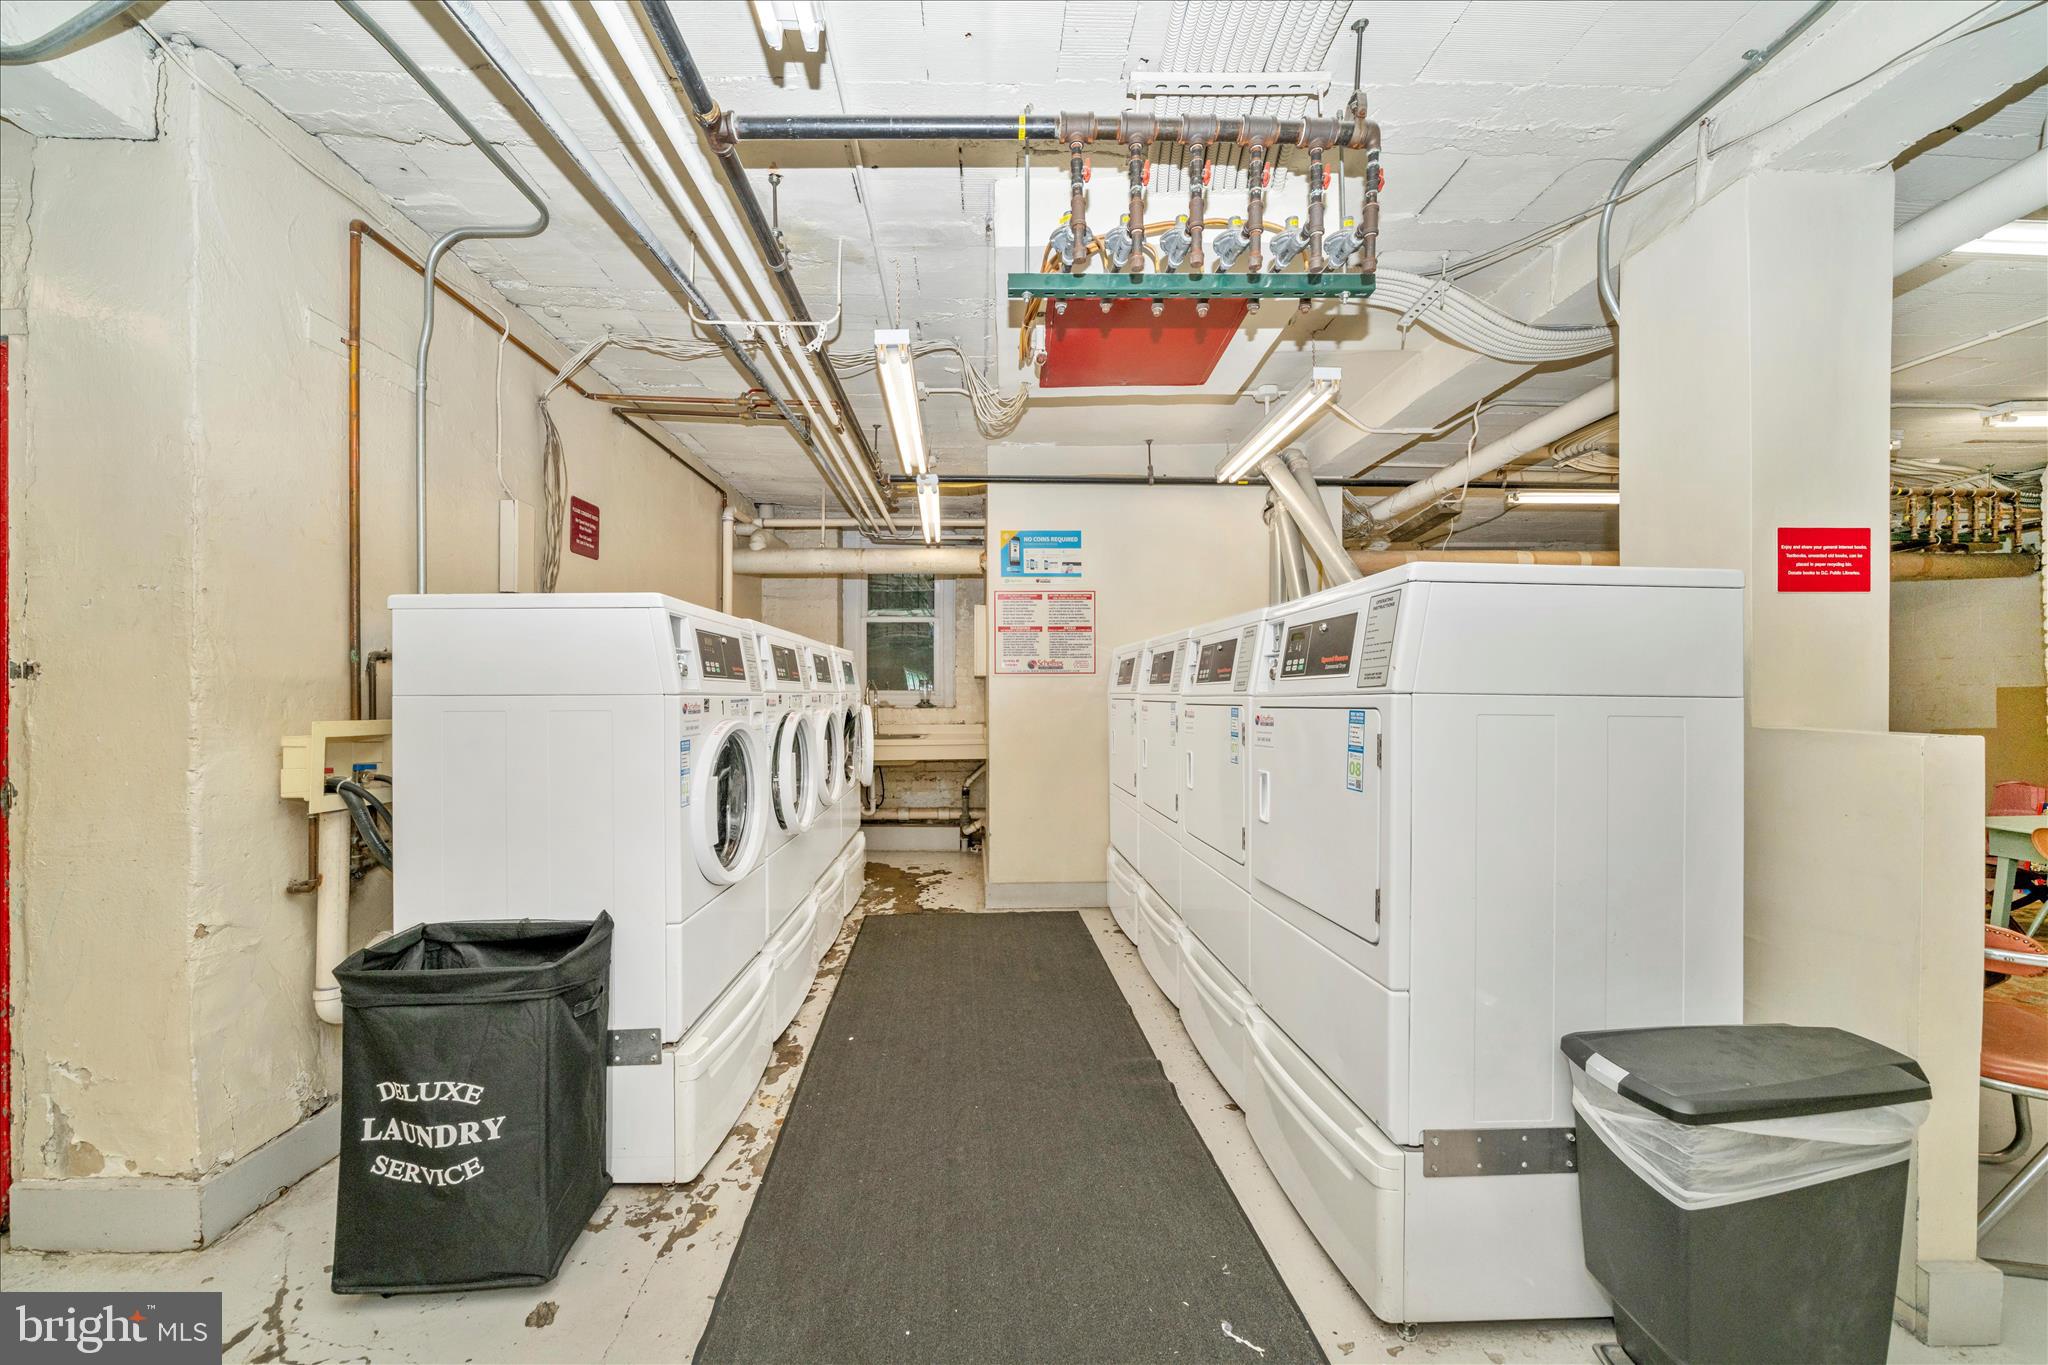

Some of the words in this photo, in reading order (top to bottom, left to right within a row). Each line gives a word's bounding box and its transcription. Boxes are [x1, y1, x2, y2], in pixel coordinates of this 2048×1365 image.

[1051, 536, 1079, 544] REQUIRED
[1373, 602, 1396, 611] INSTRUCTIONS
[1375, 596, 1394, 605] OPERATING
[1349, 761, 1362, 777] 08
[376, 1081, 485, 1105] DELUXE
[361, 1116, 507, 1148] LAUNDRY
[370, 1155, 485, 1186] SERVICE
